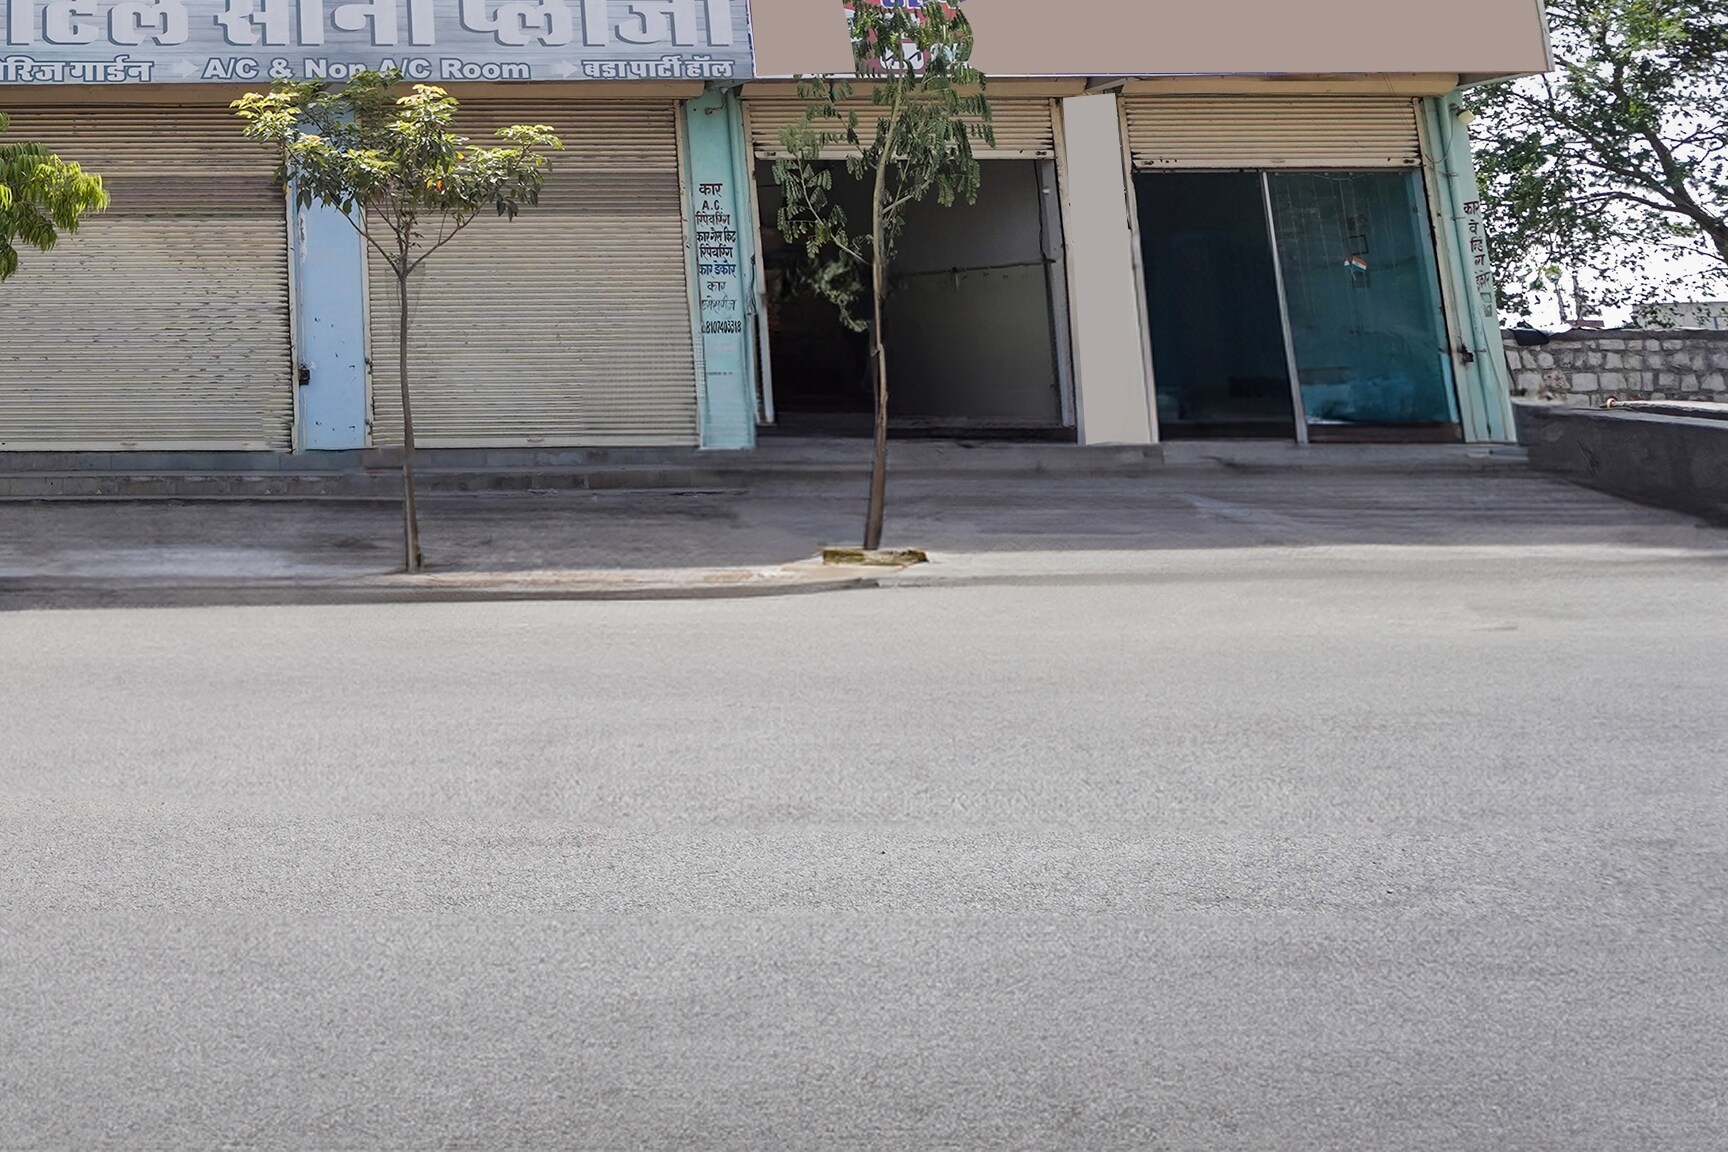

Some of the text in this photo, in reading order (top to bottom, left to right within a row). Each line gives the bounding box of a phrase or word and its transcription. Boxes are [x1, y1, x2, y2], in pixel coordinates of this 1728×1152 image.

[201, 56, 531, 80] A/C & Non A/C Room
[684, 54, 735, 79] हॉल
[699, 183, 723, 198] कार
[702, 200, 723, 210] A.C.
[699, 263, 714, 278] कार
[707, 281, 727, 295] कार
